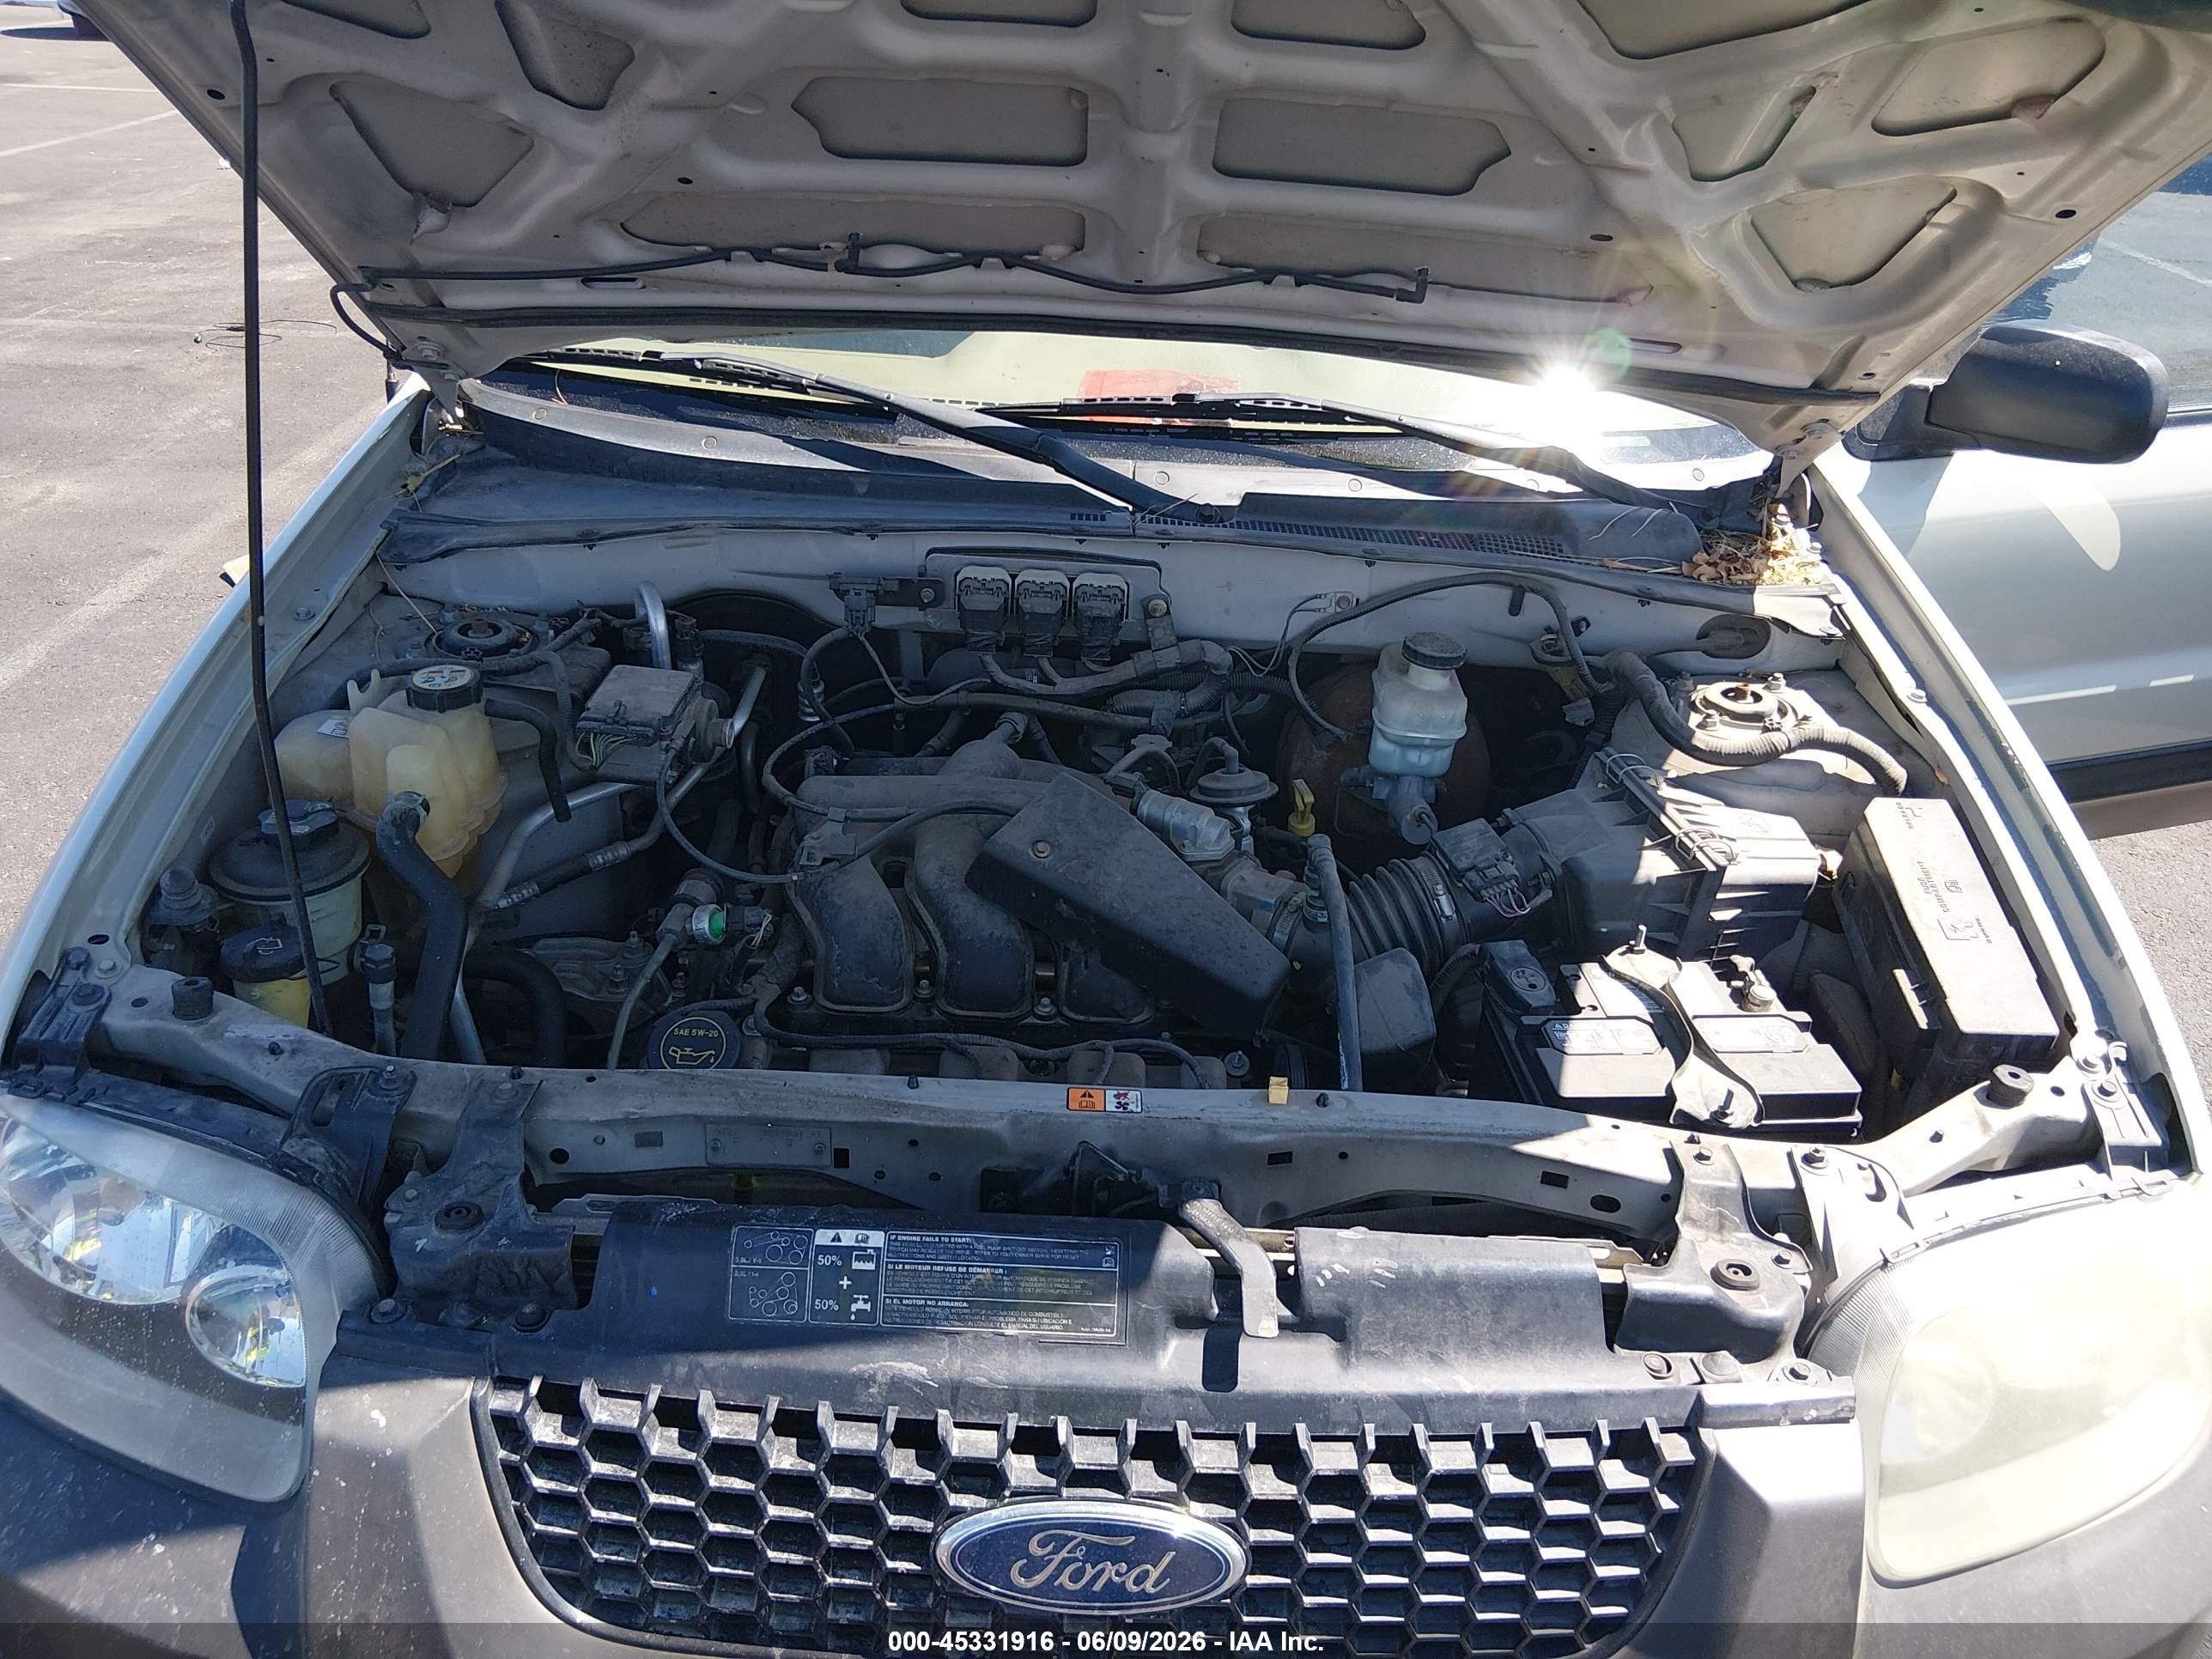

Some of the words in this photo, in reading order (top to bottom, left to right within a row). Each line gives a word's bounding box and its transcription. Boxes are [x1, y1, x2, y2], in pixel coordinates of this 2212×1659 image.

[673, 1028, 690, 1036] SAE
[691, 1028, 719, 1037] 5W-20
[817, 1255, 842, 1266] 50%
[815, 1299, 839, 1310] 50%
[1011, 1529, 1176, 1594] Ford
